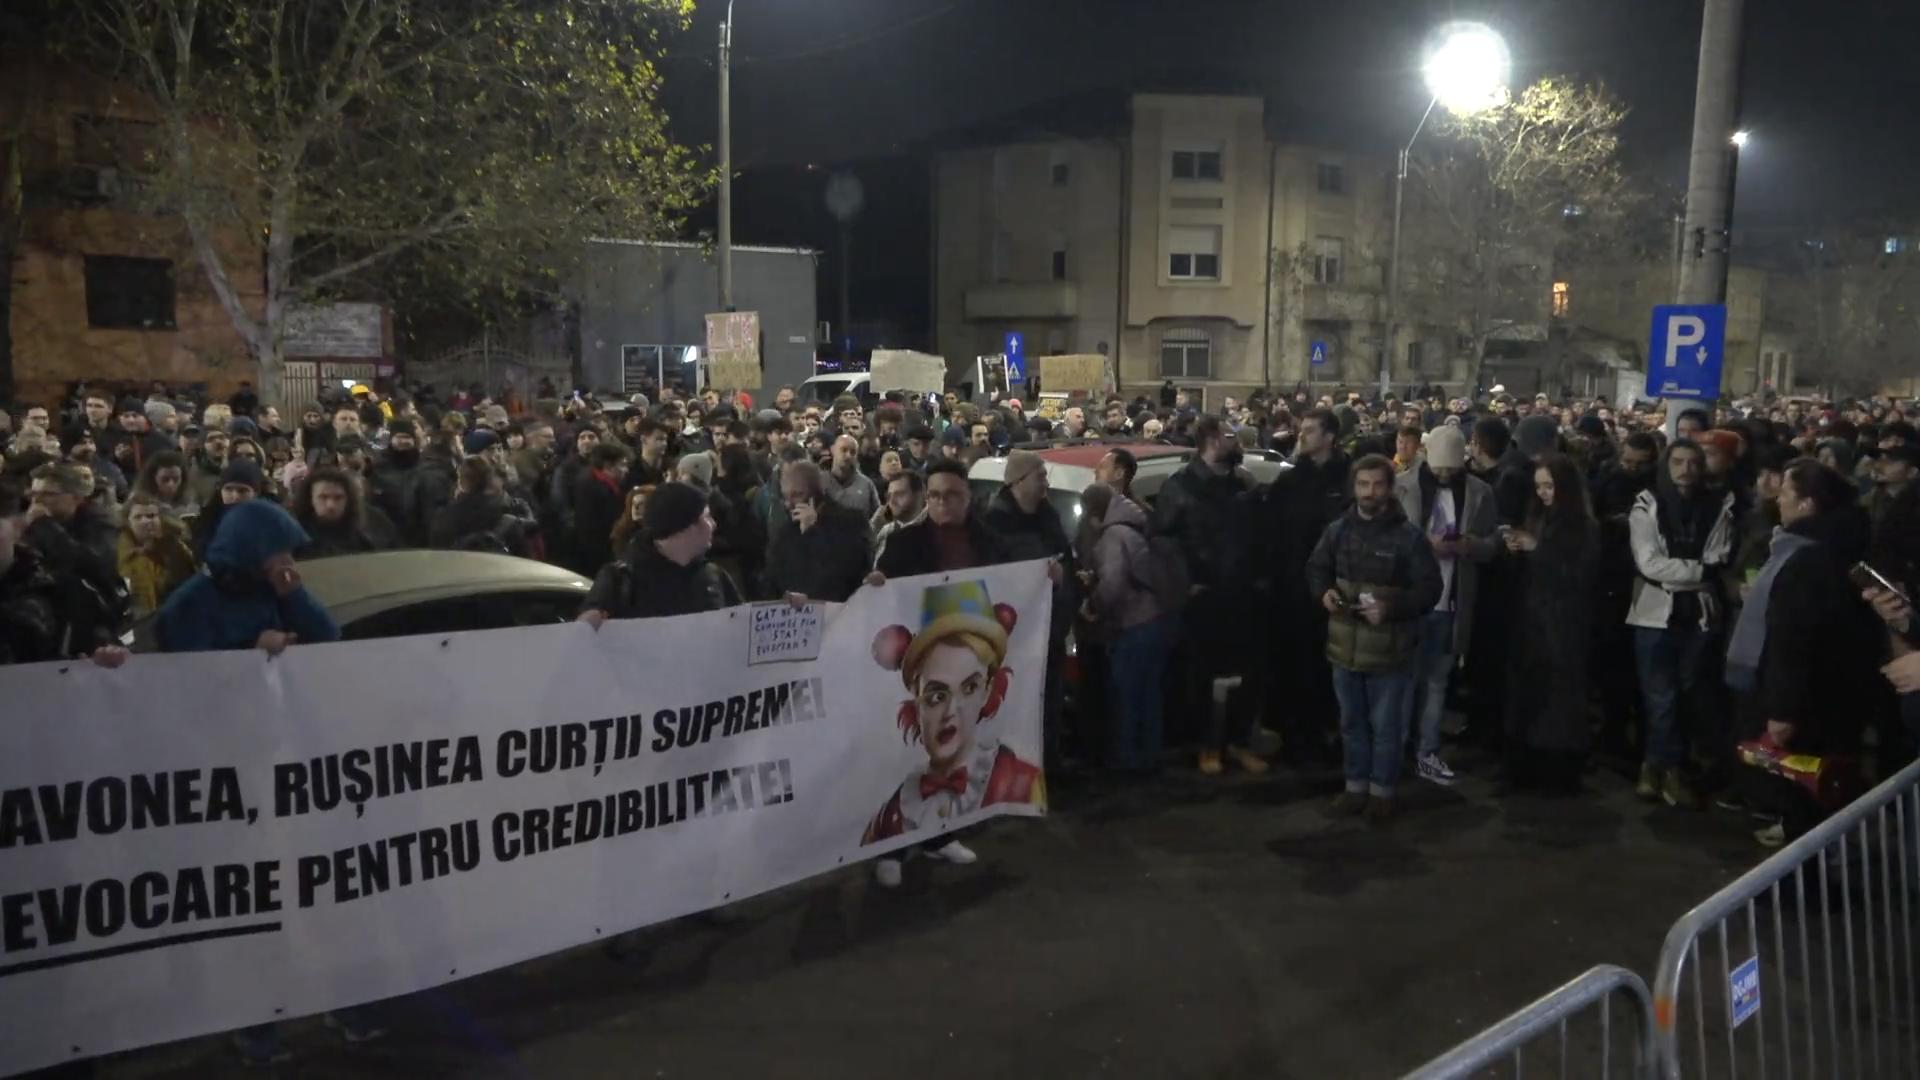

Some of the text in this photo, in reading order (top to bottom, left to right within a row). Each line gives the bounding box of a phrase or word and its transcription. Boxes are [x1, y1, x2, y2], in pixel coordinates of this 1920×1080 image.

[1665, 315, 1706, 367] P
[772, 629, 798, 641] STAT
[0, 767, 259, 848] AVONEA,
[274, 735, 483, 819] RUȘINEA
[496, 714, 642, 776] CURȚII
[1, 758, 795, 951] EVOCARE PENTRU CREDIBILITATE!
